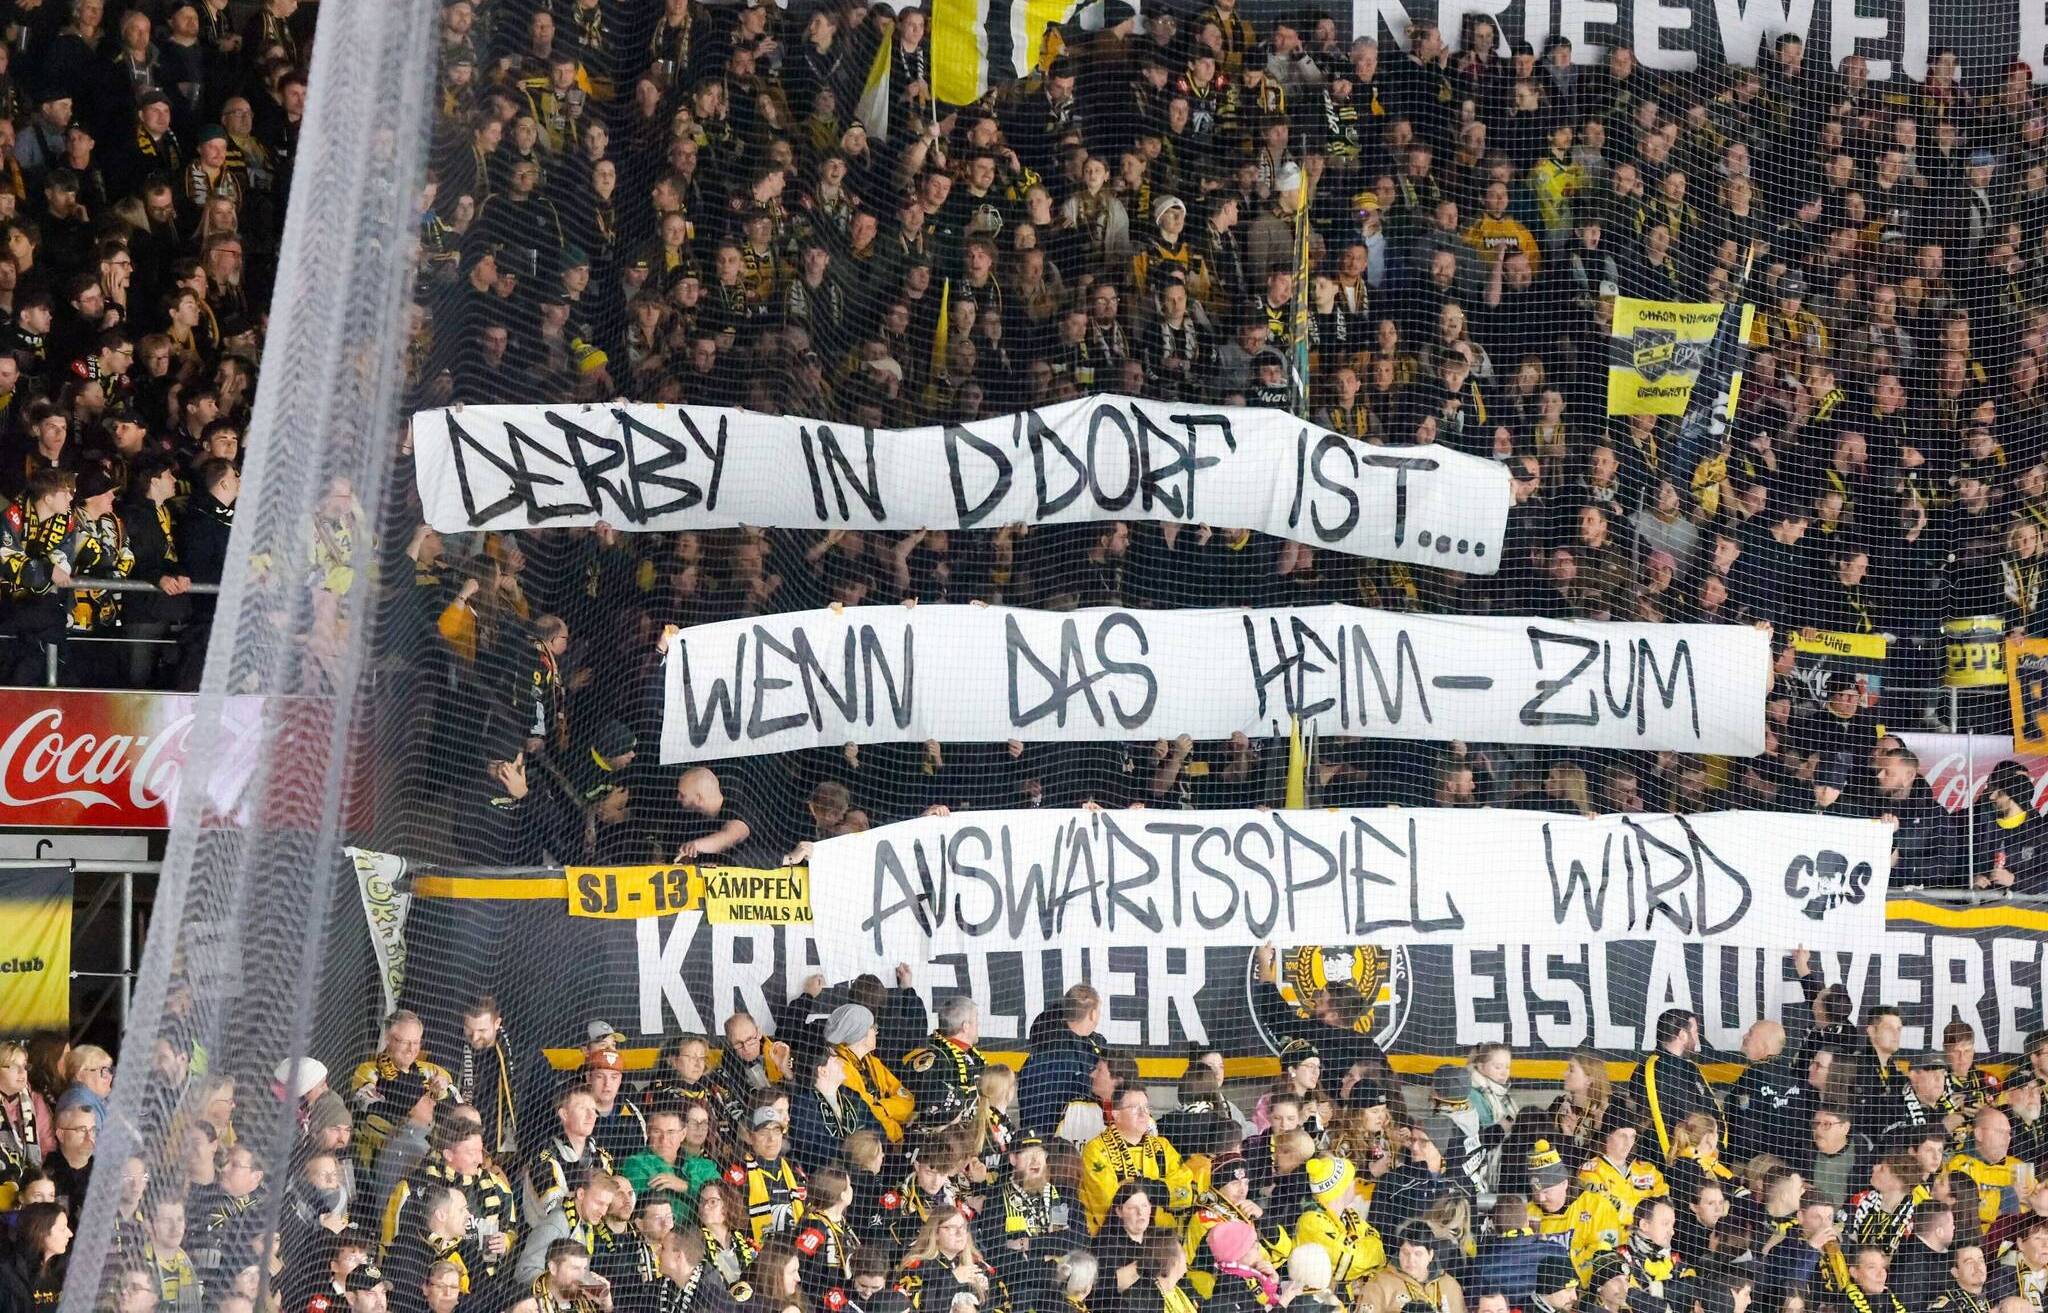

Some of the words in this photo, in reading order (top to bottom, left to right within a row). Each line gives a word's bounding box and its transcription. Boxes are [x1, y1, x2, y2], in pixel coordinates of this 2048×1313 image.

[445, 408, 728, 527] DERBY
[800, 424, 888, 522] IN
[943, 402, 1236, 529] D'DORF
[680, 624, 914, 748] WENN
[1006, 612, 1158, 729] DAS
[1519, 626, 1700, 739] ZUM
[0, 707, 255, 810] Coca-C
[650, 869, 689, 911] 13
[704, 872, 802, 900] KÄMPFEN
[729, 905, 790, 922] NIEMALS
[861, 812, 1465, 955] AUSWÄRTSSPIEL
[1542, 815, 1752, 937] WIRD
[636, 910, 1210, 1046] KRELDER
[1452, 930, 2048, 1054] EISLAUFVERE
